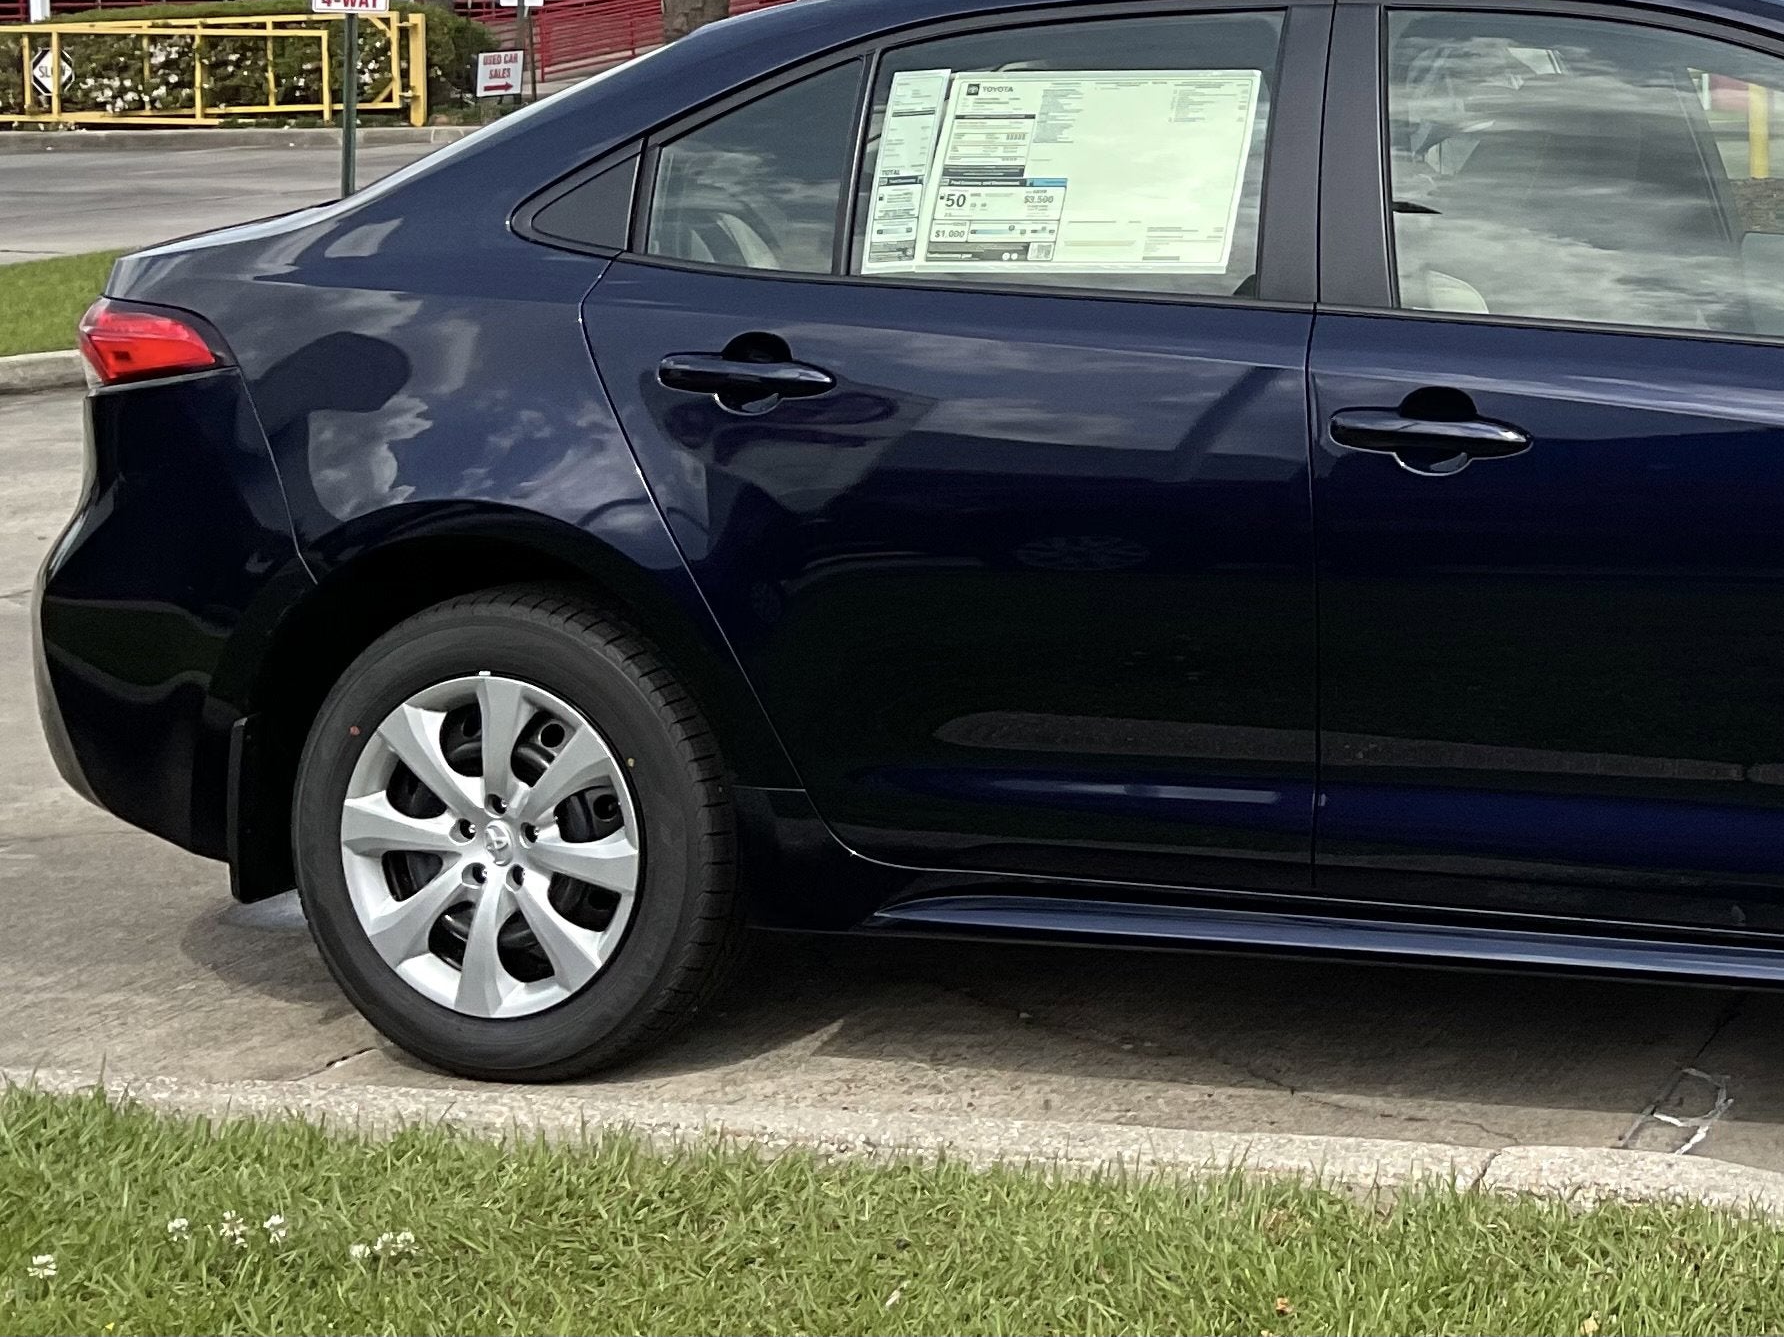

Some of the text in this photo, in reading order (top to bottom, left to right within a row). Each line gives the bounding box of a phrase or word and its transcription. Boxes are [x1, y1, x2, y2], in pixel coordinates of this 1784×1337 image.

[483, 52, 519, 66] USED CAR
[38, 65, 68, 78] SLW
[488, 67, 512, 79] SALES
[982, 85, 1014, 93] TOYOTA
[945, 193, 967, 208] 50
